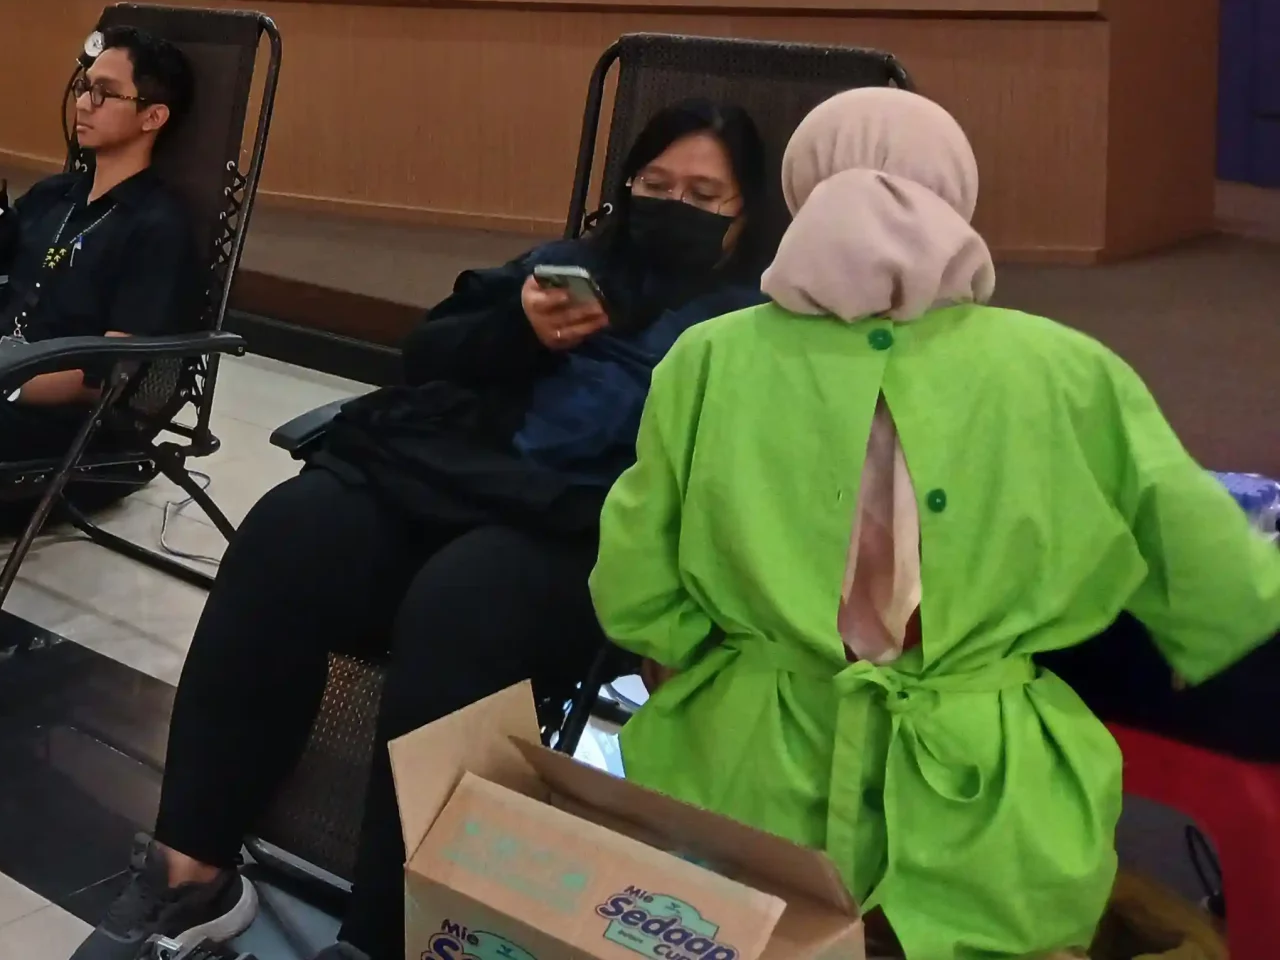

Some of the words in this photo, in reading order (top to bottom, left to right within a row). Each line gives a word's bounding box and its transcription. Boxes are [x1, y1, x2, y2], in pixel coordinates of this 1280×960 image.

[624, 885, 654, 904] Mie
[441, 918, 480, 947] Mie
[597, 895, 738, 960] Sedaap
